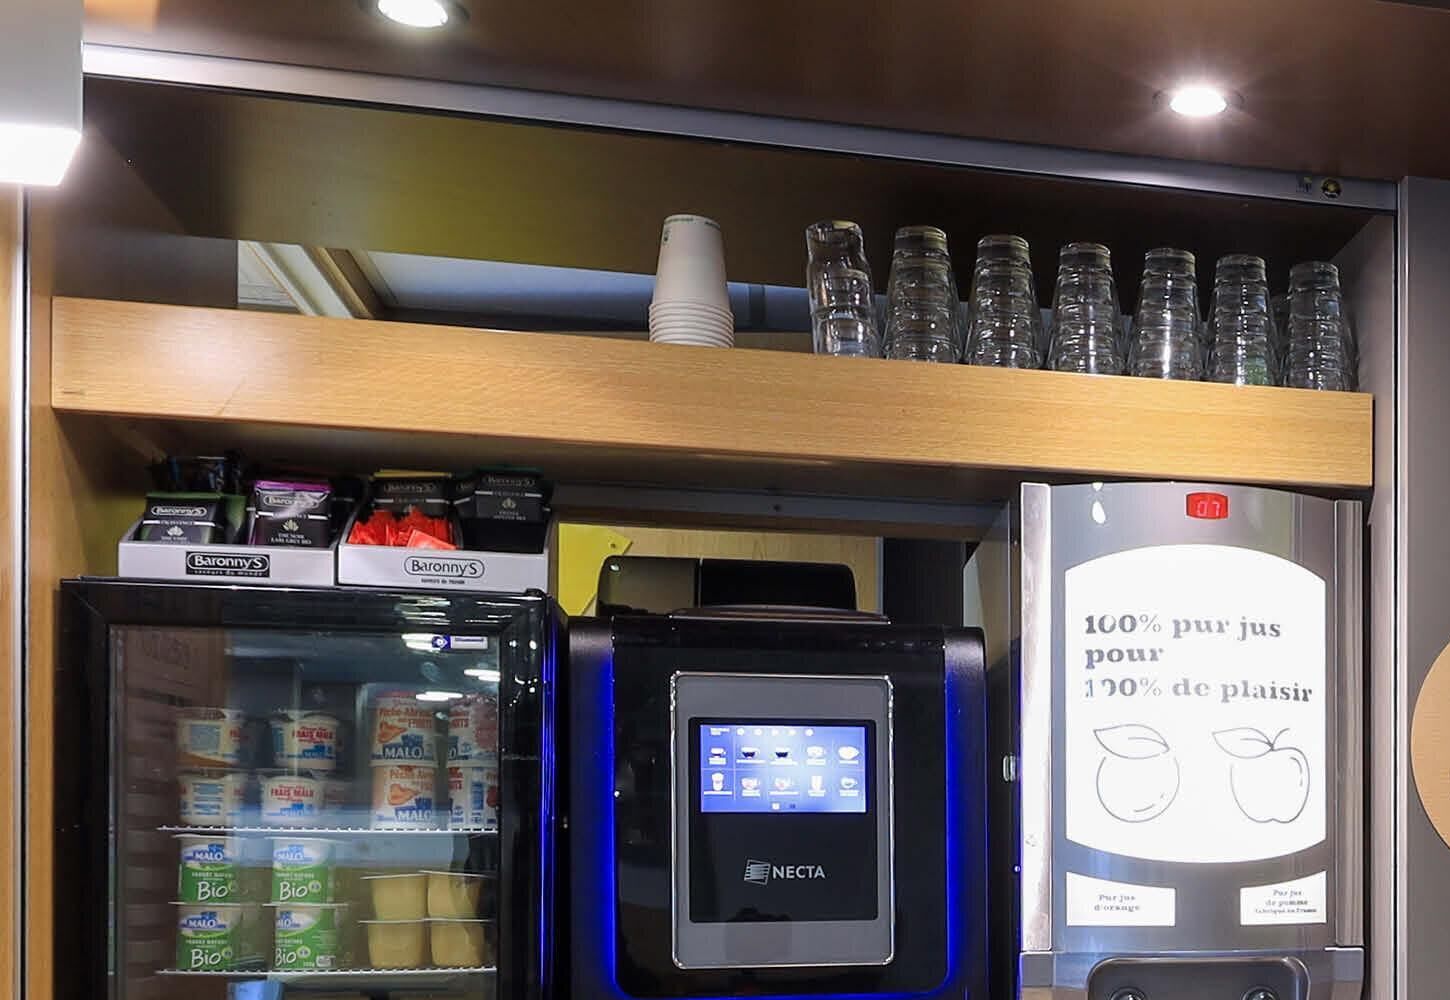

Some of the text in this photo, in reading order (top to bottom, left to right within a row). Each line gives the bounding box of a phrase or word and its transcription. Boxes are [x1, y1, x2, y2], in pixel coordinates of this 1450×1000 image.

[1085, 614, 1281, 641] 100% pur jus
[1085, 647, 1164, 669] pour
[1172, 678, 1209, 697] de
[1220, 680, 1312, 703] plaisir
[385, 746, 423, 758] MALO
[772, 865, 826, 879] NECTA
[197, 881, 228, 900] Bio
[280, 881, 308, 900] Bio
[191, 949, 221, 968] Bio
